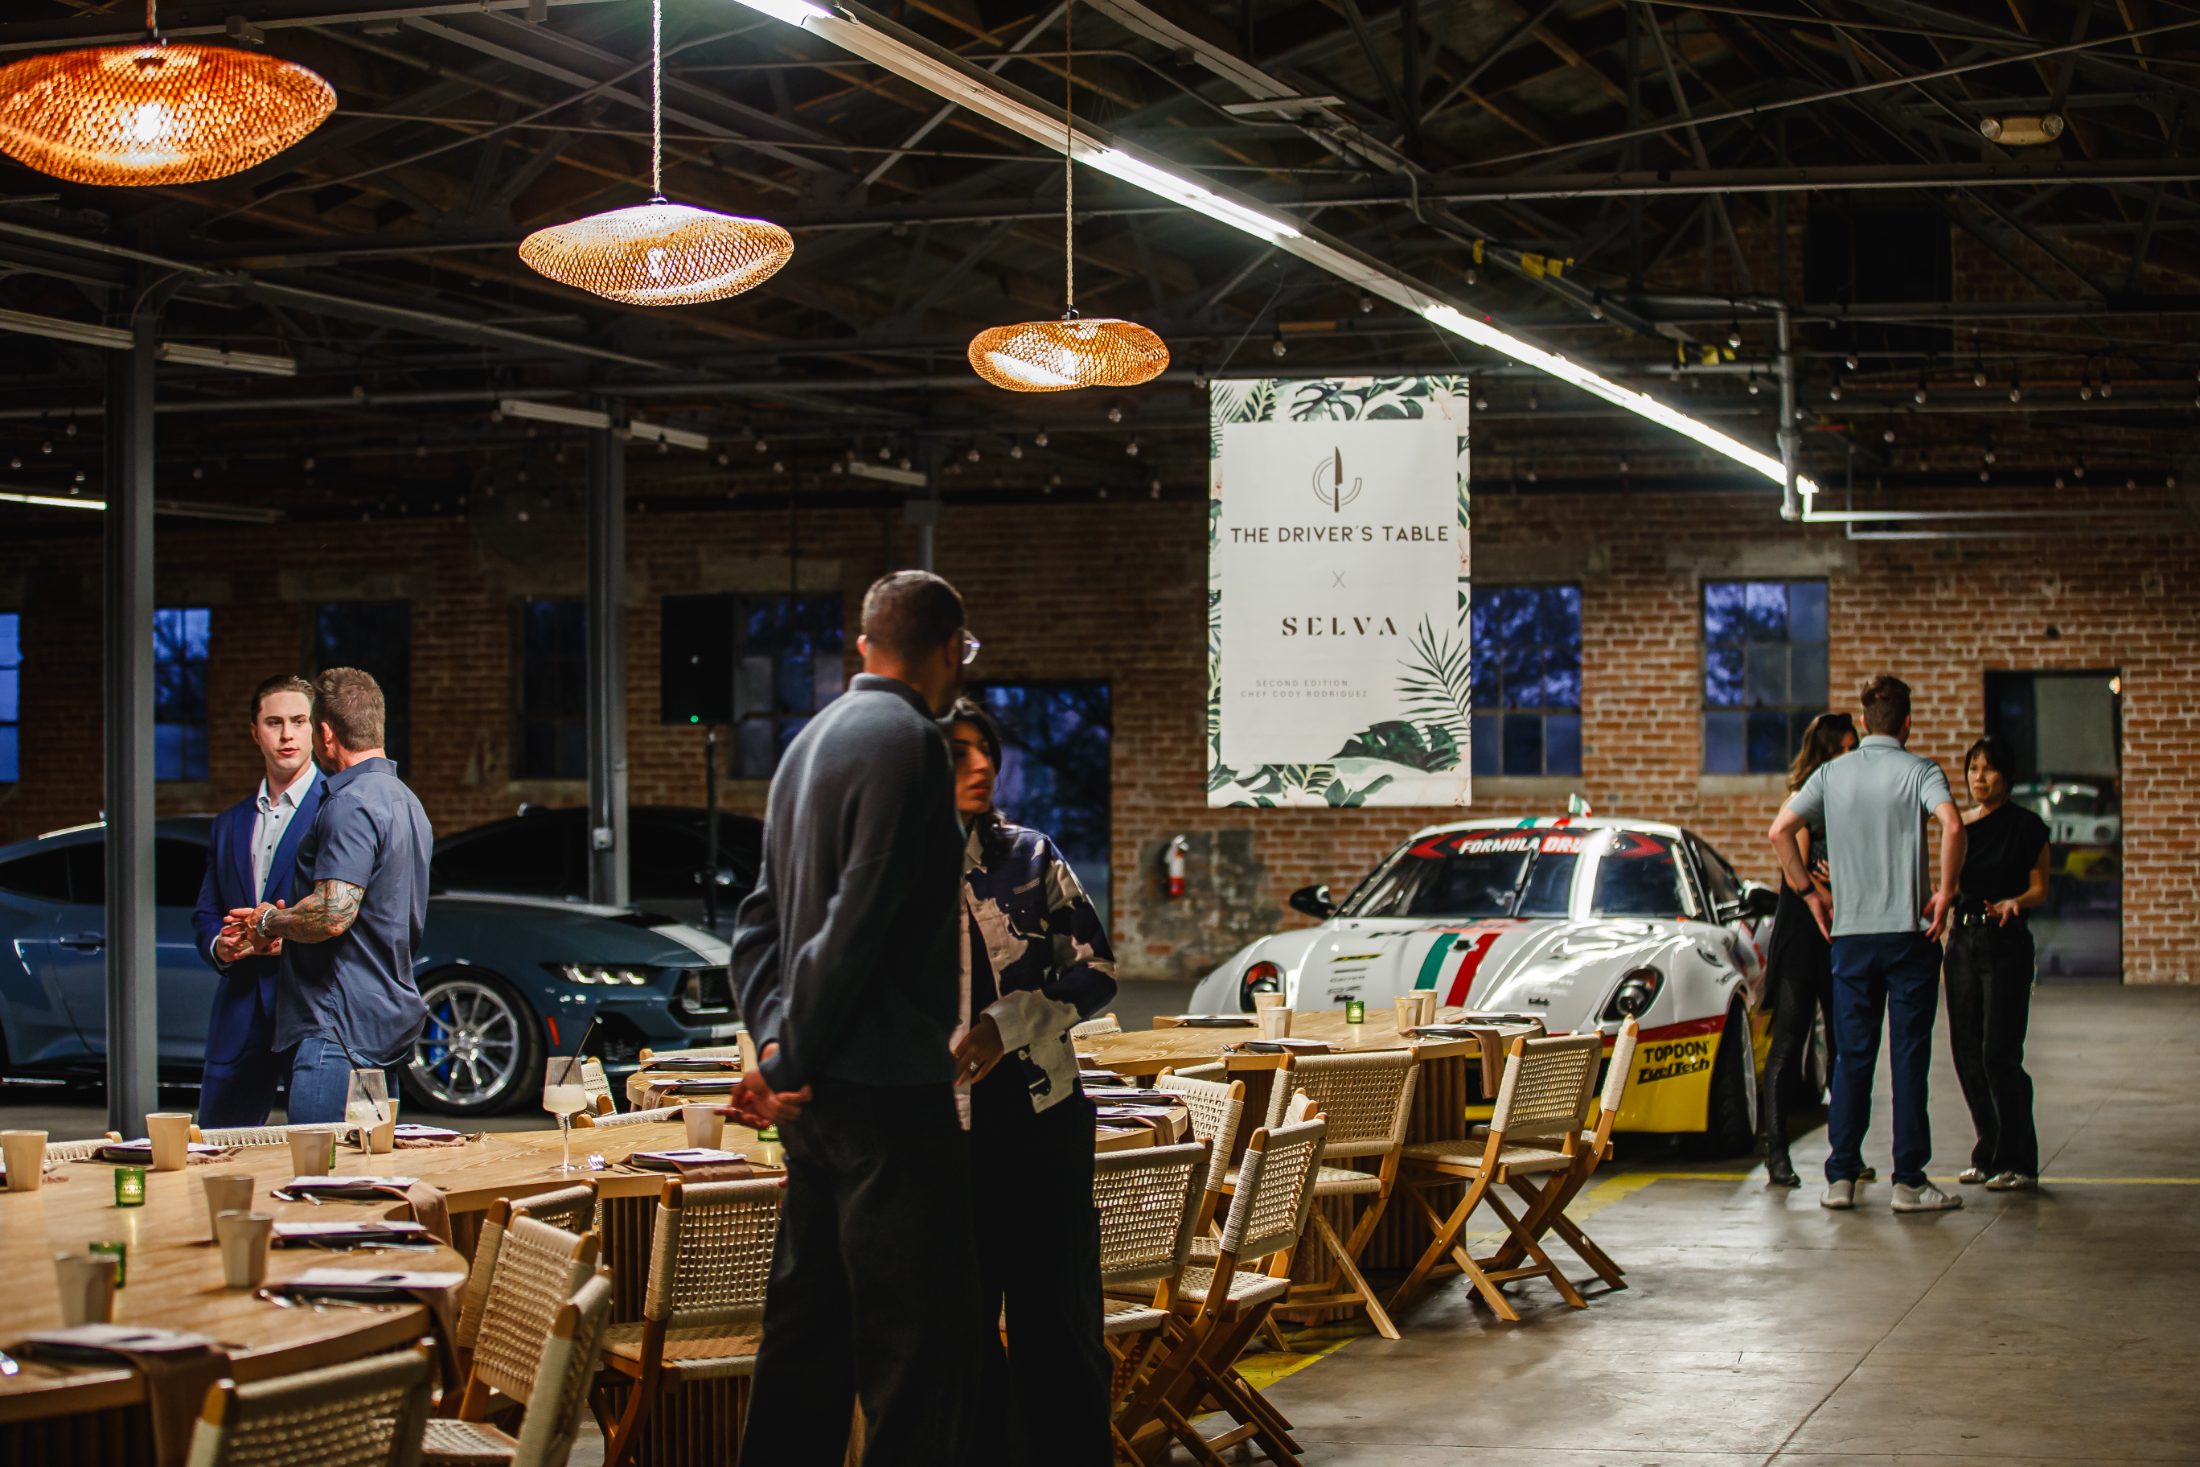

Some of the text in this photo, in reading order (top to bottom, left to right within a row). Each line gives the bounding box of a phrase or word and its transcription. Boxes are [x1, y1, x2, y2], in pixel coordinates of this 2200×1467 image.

[1230, 525, 1449, 543] THE DRIVER'S TABLE
[1281, 616, 1398, 636] SELVA
[1256, 679, 1299, 688] SECOND
[1240, 690, 1368, 698] CHEF CODY RODRIGUEZ
[1458, 835, 1588, 855] FORMULA DRI
[1643, 1041, 1709, 1064] TOPDON
